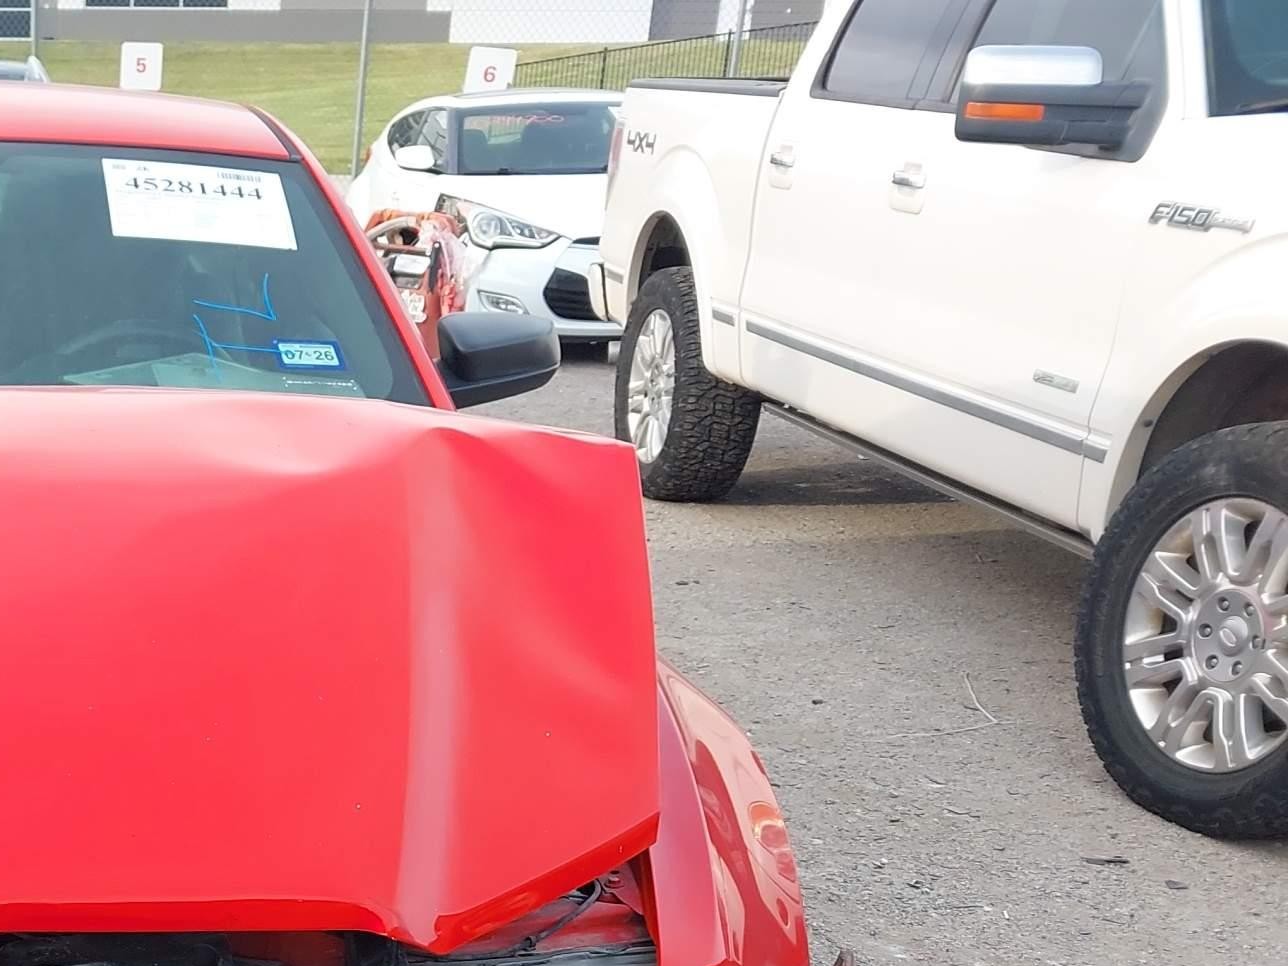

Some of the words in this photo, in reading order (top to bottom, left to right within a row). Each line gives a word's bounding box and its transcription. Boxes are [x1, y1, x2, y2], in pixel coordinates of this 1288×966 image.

[135, 57, 147, 73] 5
[483, 65, 498, 83] 6
[124, 176, 263, 201] 45281444
